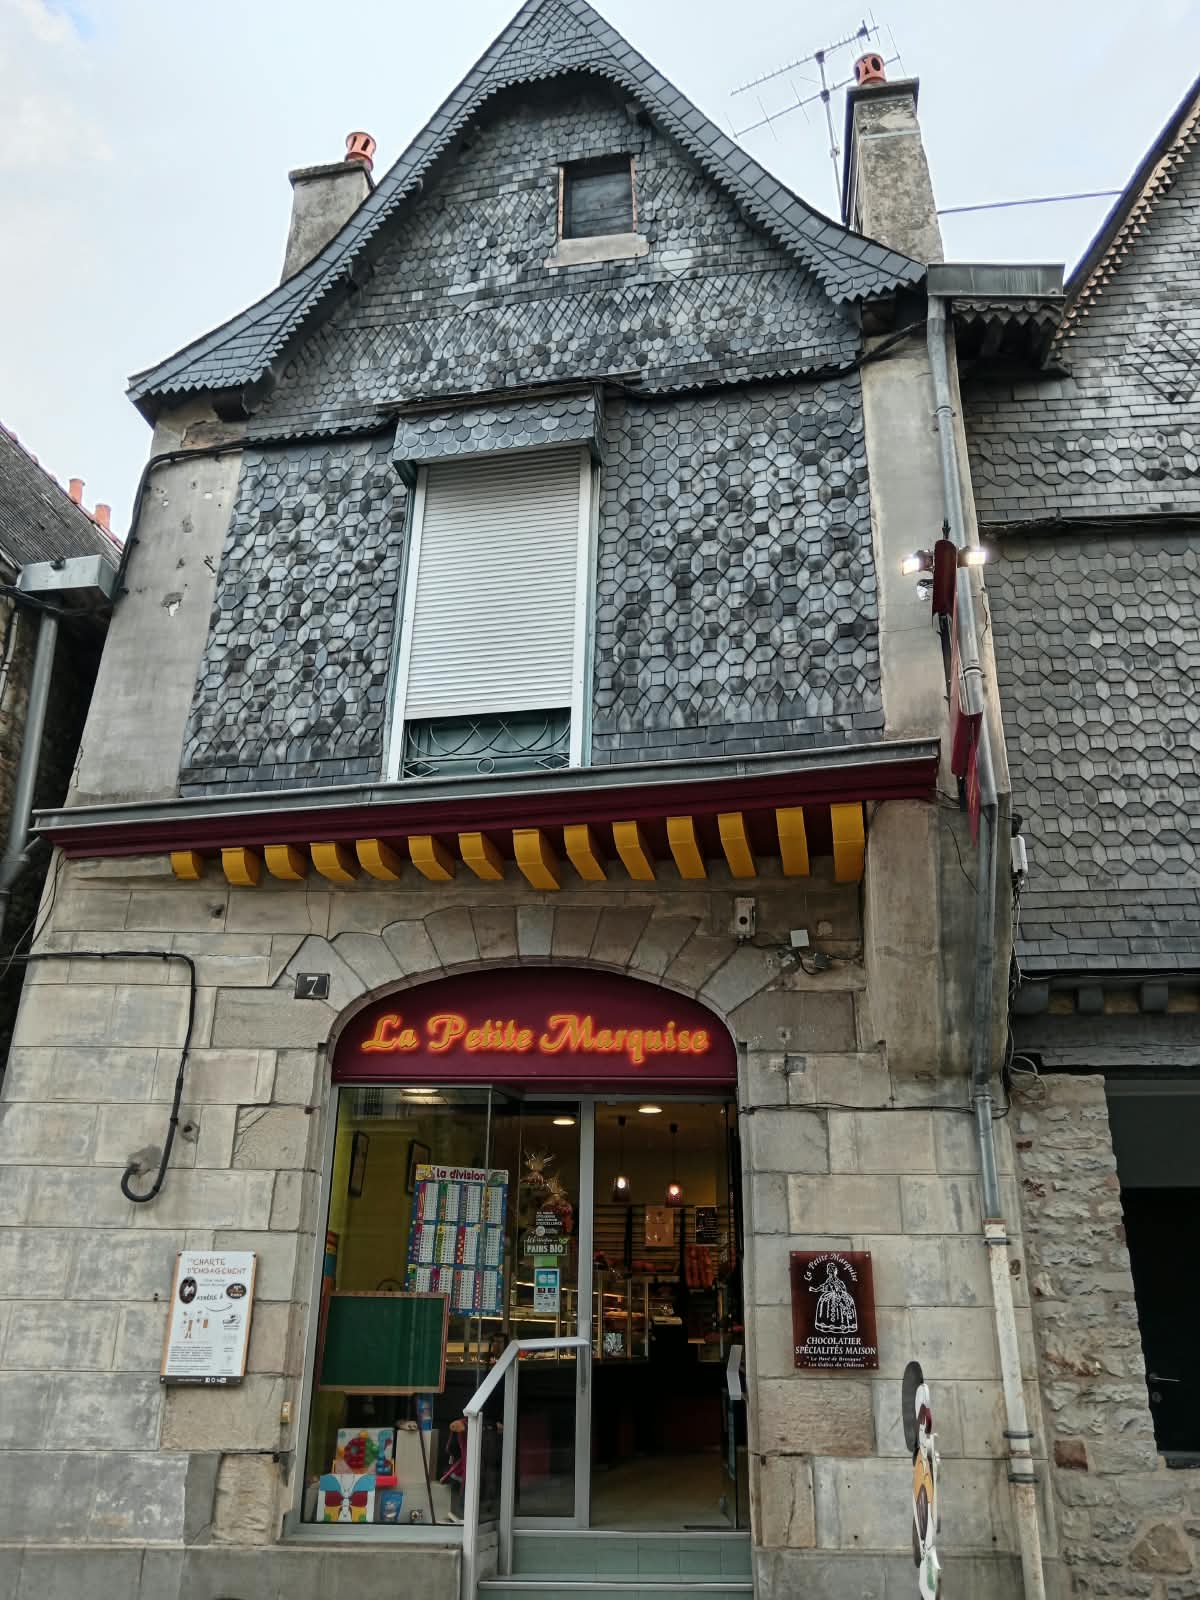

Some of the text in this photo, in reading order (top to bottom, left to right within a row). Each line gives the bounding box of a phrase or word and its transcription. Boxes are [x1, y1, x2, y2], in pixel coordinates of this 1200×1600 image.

[306, 976, 319, 995] 7
[362, 1013, 710, 1063] La Petite Marquise
[449, 1168, 486, 1181] division
[527, 1243, 563, 1253] PAINS BIO
[193, 1258, 225, 1266] CHARTE
[803, 1252, 858, 1282] La Petite Marquise
[806, 1336, 862, 1345] CHOCOLATIER
[795, 1344, 876, 1355] SPÉCIALITÉS MAISON
